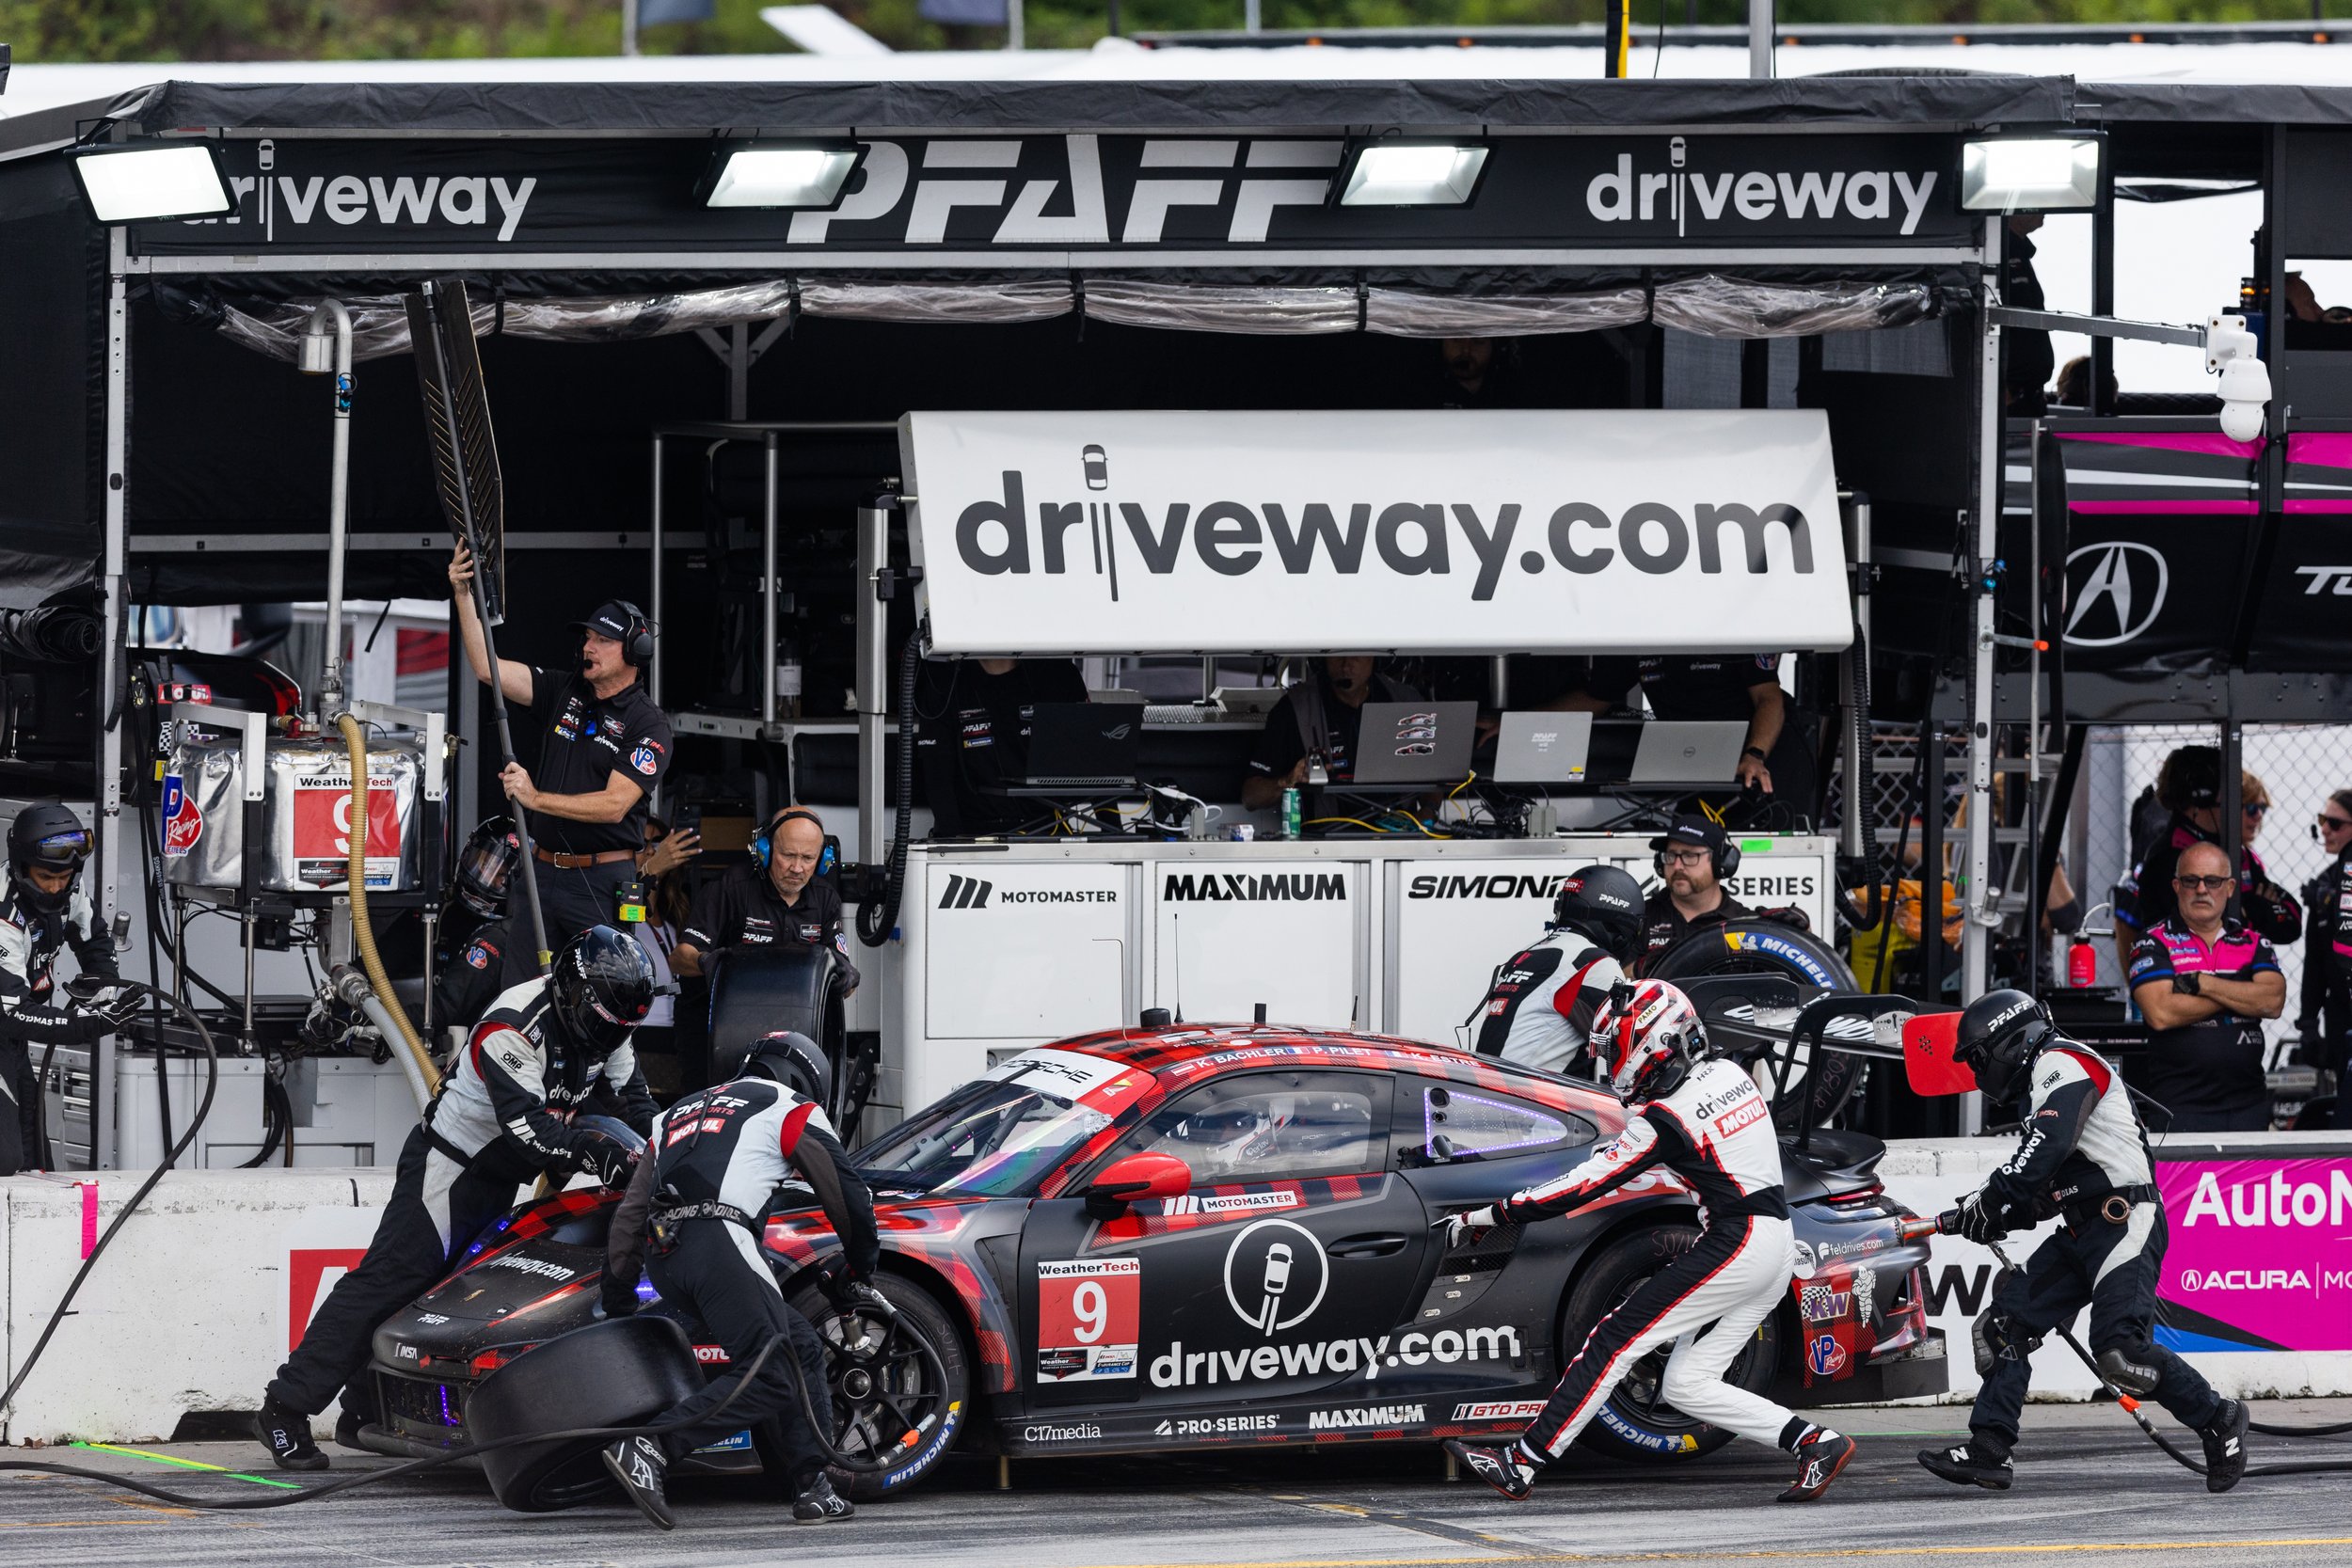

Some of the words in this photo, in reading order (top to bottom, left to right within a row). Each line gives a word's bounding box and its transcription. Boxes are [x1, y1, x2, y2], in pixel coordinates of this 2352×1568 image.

[183, 150, 537, 241] riveway
[787, 135, 1343, 243] PFAFF
[1586, 139, 1939, 236] driveway
[954, 451, 1816, 603] driveway.com
[333, 793, 370, 855] 9
[1001, 891, 1117, 903] MOTOMASTER
[1163, 874, 1347, 901] MAXIMUM
[1407, 875, 1566, 899] SIMONI
[1728, 877, 1814, 895] SERIES
[1599, 893, 1630, 909] PFAFF
[742, 932, 773, 944] PFAFF
[574, 947, 588, 980] PFAFF
[1638, 1005, 1658, 1024] PAMO
[1987, 999, 2030, 1034] PFAFF
[502, 1052, 523, 1070] OMP
[1197, 1059, 1214, 1069] K.
[1214, 1048, 1288, 1064] BACHLER
[1328, 1047, 1371, 1056] PILET
[1430, 1055, 1482, 1068] ESTRE
[1696, 1065, 1716, 1082] HRX
[2042, 1070, 2061, 1089] OMP
[668, 1108, 737, 1129] MOTORSORTS
[1723, 1101, 1767, 1134] MOTUL
[1207, 1193, 1296, 1211] MOTOMASTER
[1830, 1239, 1884, 1256] feldrives.com
[489, 1250, 576, 1282] driveway.com
[1038, 1261, 1139, 1275] WeatherTech
[2201, 1270, 2312, 1291] ACURA
[1073, 1280, 1108, 1344] 9
[1810, 1292, 1851, 1319] KW
[1150, 1325, 1522, 1388] driveway.com
[1810, 1335, 1836, 1373] VP
[1309, 1403, 1425, 1429] MAXIMUM
[1472, 1403, 1512, 1417] GTD
[1025, 1422, 1102, 1442] C17media
[1597, 1404, 1663, 1449] MICHEL
[889, 1427, 951, 1485] MICHELIN
